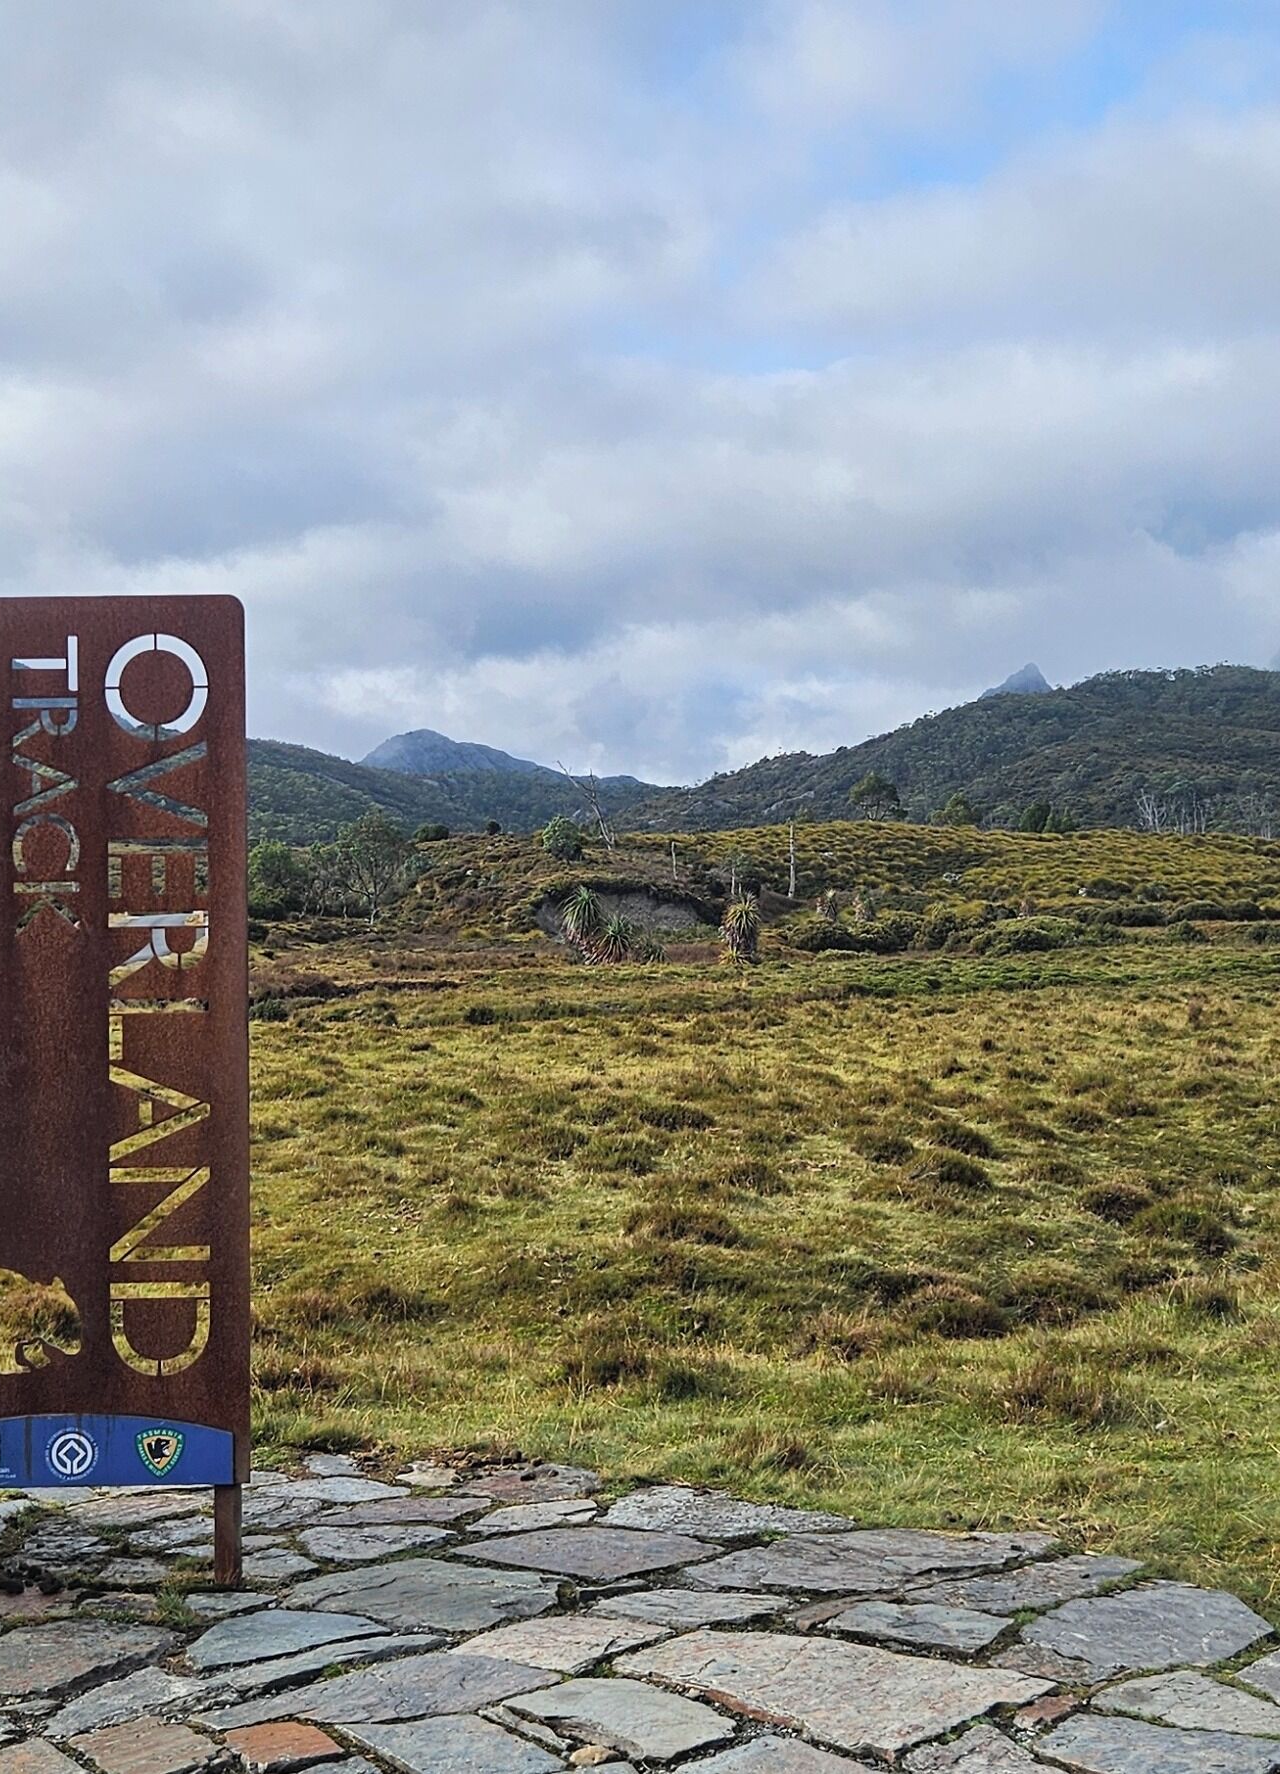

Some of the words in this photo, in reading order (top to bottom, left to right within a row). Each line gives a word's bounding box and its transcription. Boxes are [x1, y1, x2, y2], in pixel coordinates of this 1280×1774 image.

[11, 634, 80, 937] TRACK
[104, 632, 211, 1377] OVERLAND
[137, 1428, 183, 1440] TASMANIA
